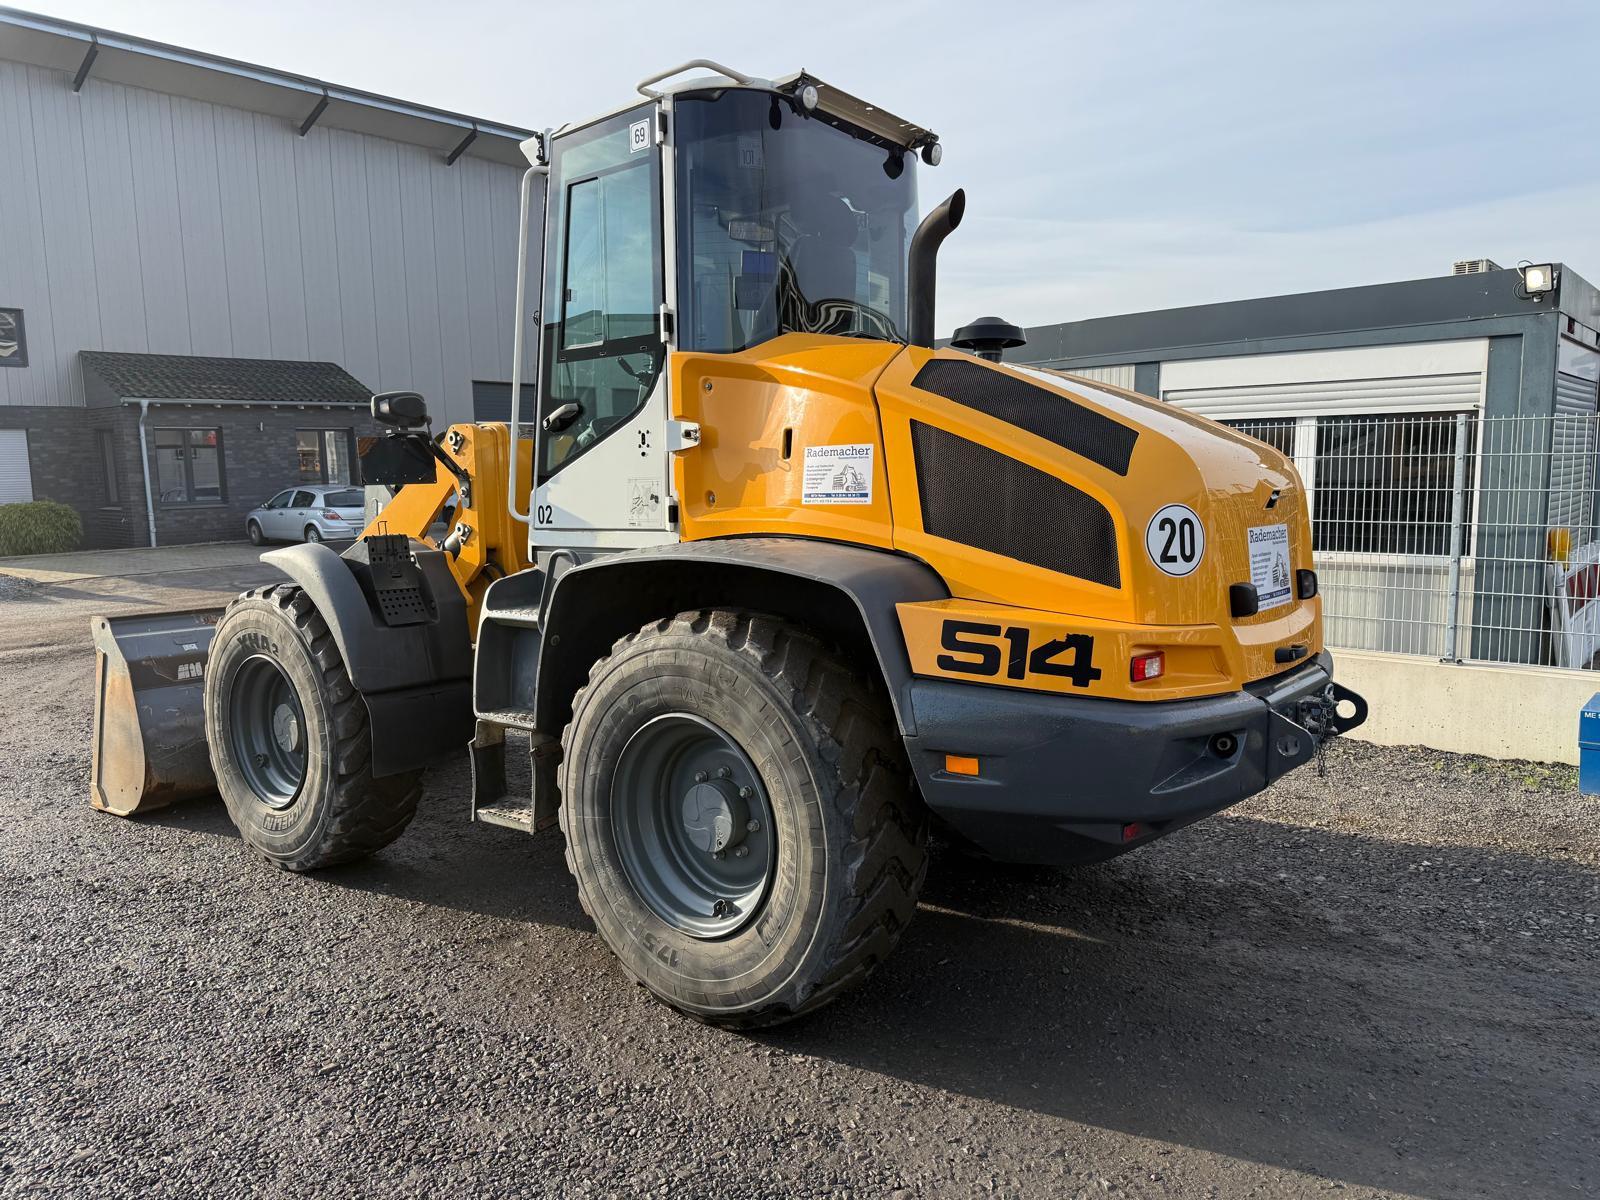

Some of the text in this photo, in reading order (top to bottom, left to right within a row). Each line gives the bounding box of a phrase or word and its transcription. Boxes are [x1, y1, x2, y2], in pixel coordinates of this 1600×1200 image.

[634, 126, 646, 145] 69
[806, 446, 870, 458] Rademacher
[537, 504, 553, 525] 02
[1159, 517, 1196, 564] 20
[1249, 527, 1287, 543] Rademacher
